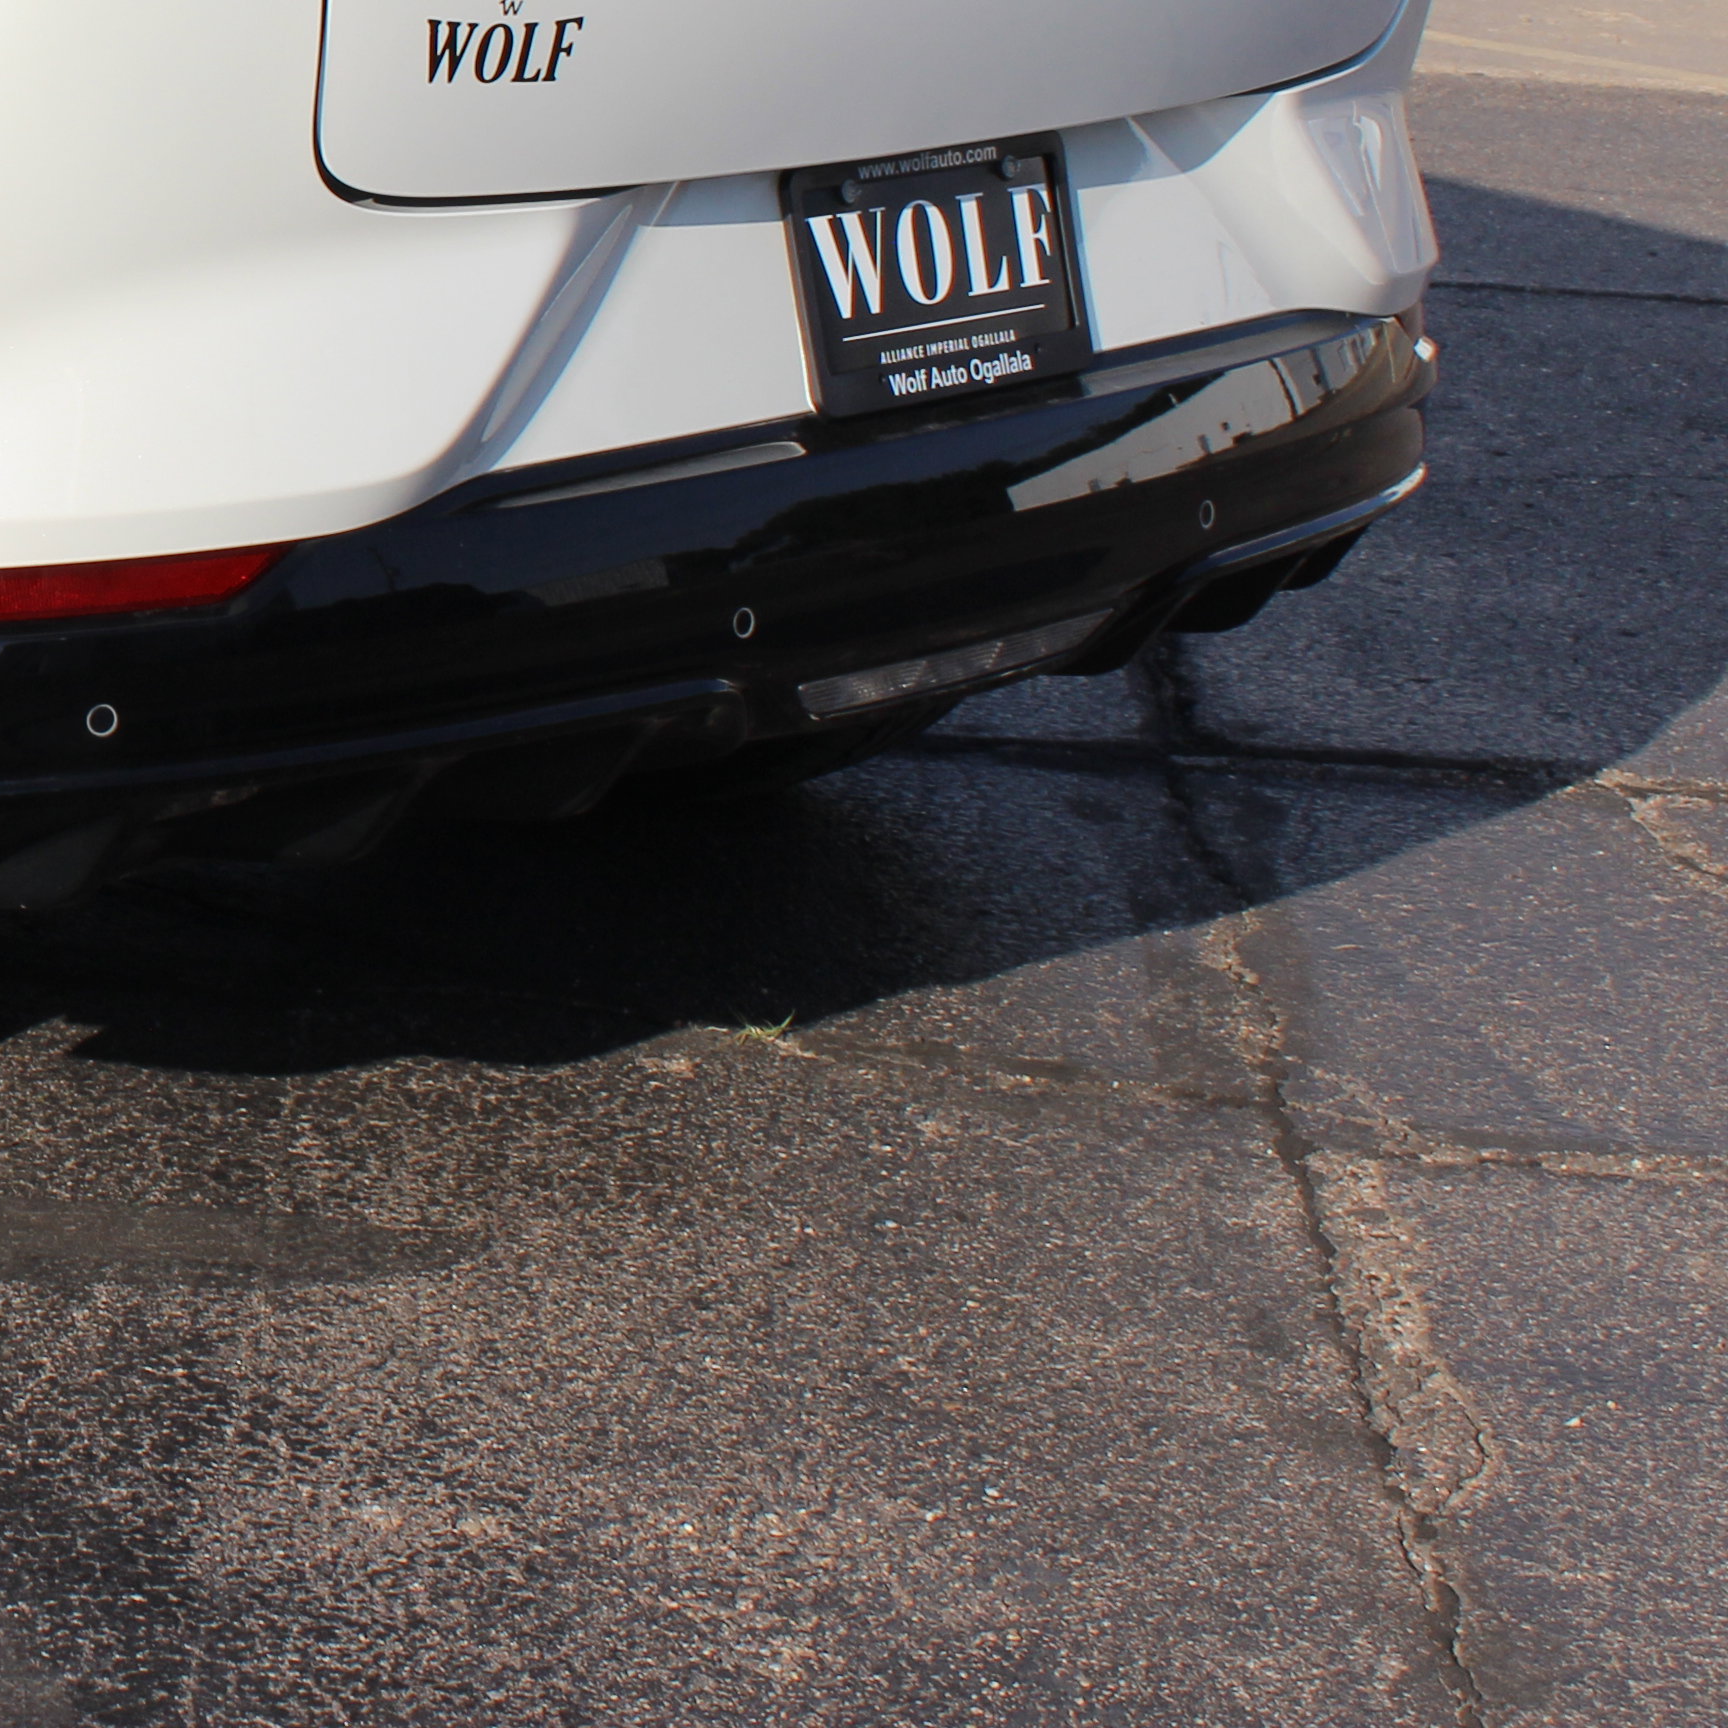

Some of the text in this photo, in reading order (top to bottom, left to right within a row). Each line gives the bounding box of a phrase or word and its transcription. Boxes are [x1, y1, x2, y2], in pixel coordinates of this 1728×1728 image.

[427, 16, 585, 84] WOLF
[857, 144, 998, 180] www.wolfauto.com
[805, 183, 1054, 320] WOLF
[879, 329, 1016, 365] ALLIANCE IMPERIAL OGALLALA
[889, 351, 1033, 396] Wolf Auto Ogallala
